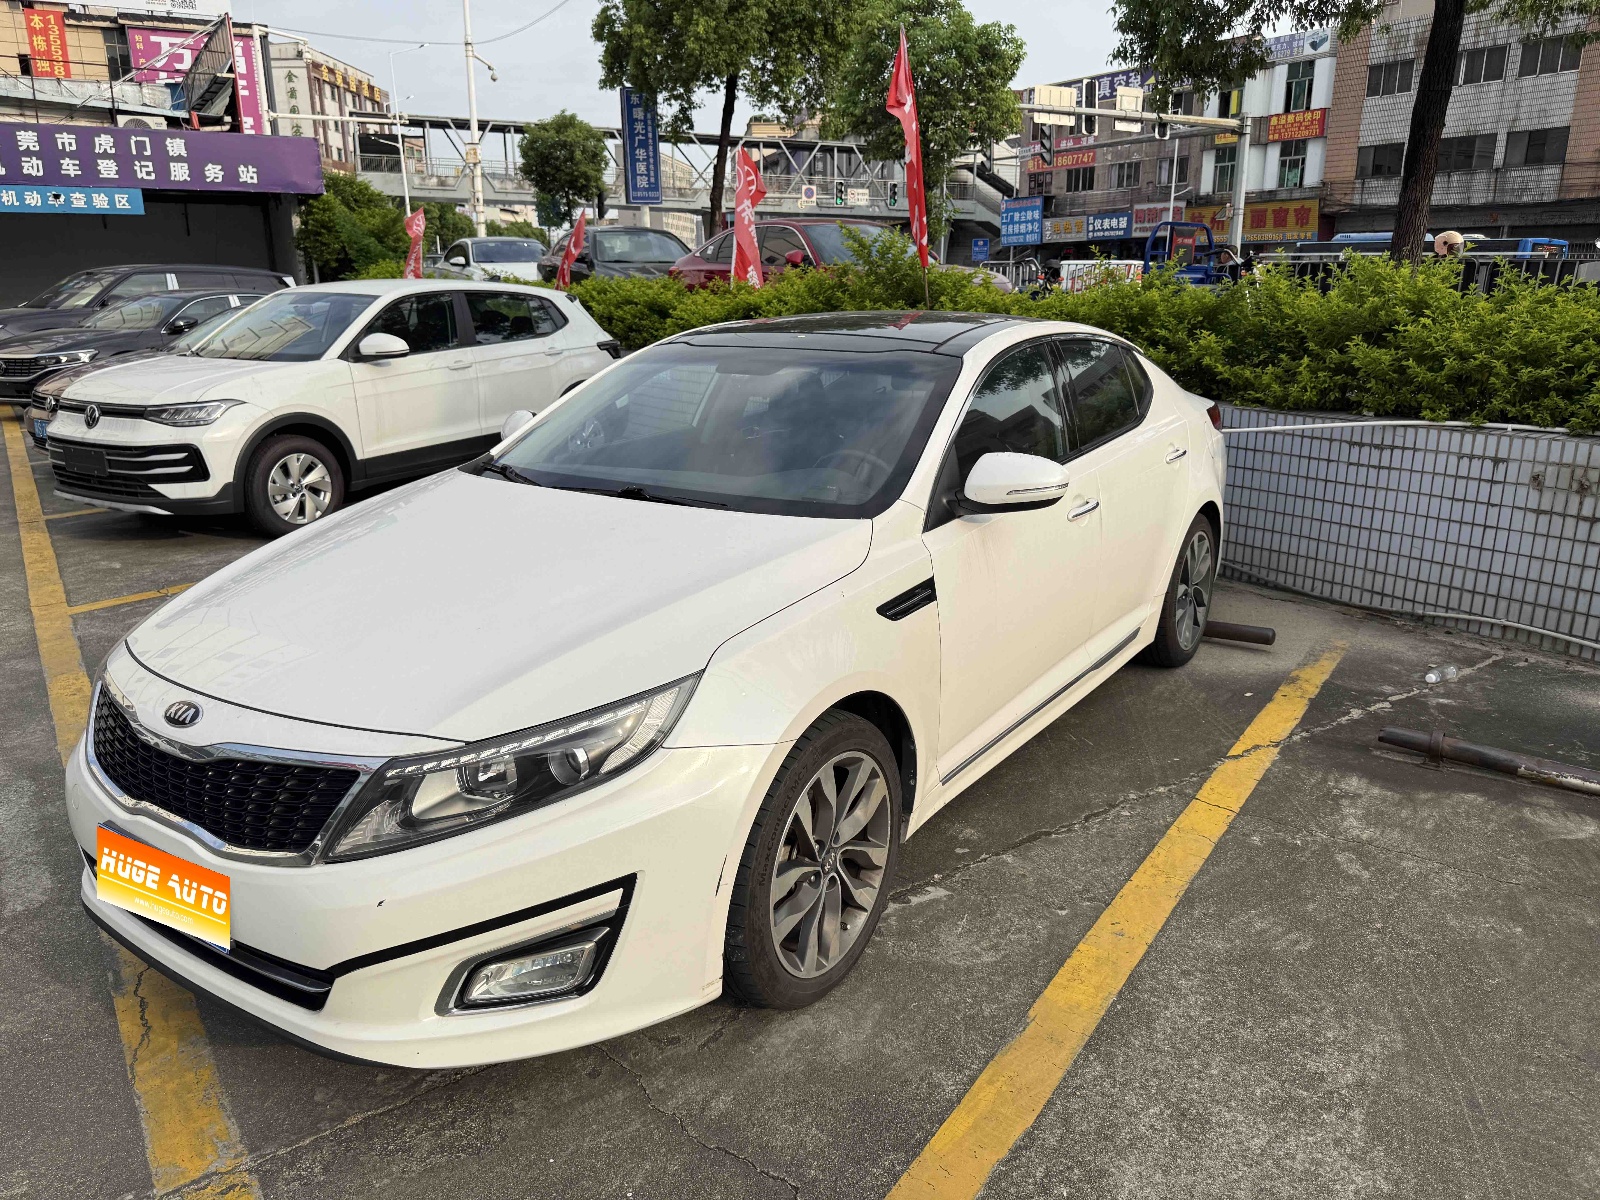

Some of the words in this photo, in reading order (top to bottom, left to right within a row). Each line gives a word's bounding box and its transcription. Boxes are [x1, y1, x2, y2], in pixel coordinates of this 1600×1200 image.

[29, 14, 51, 72] 本栋独
[45, 14, 65, 78] 135538
[1, 189, 131, 209] 机动车查验区
[1053, 219, 1083, 234] 电热管
[1093, 216, 1128, 231] 仪表电器
[1189, 204, 1312, 232] 杭州丽窗帘
[166, 702, 196, 724] KIA
